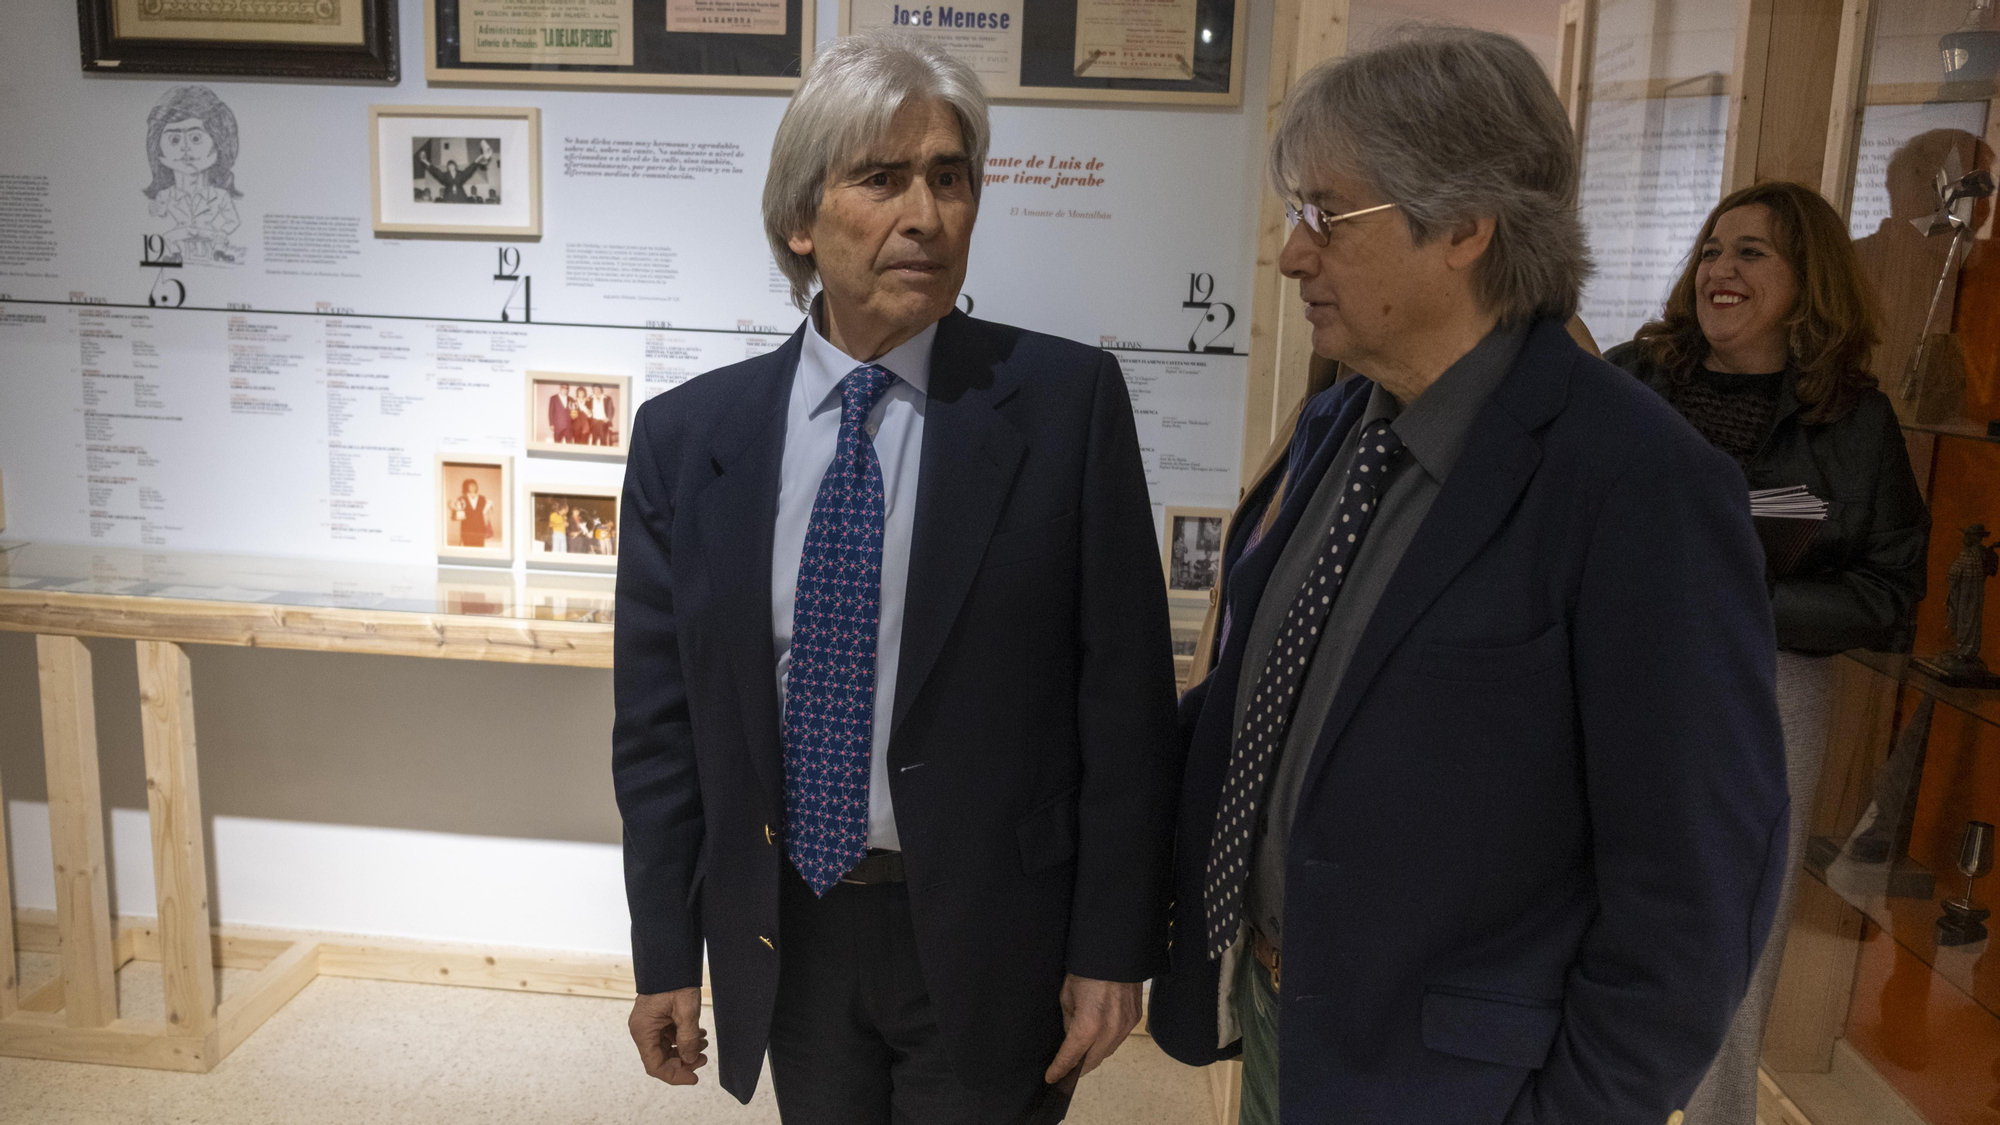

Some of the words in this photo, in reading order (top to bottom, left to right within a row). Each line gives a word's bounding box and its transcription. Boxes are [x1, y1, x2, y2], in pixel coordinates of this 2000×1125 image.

[893, 4, 933, 27] José
[938, 6, 1010, 30] Menese
[478, 25, 538, 36] Administración
[502, 38, 510, 48] de
[511, 38, 538, 49] Posadas
[1026, 155, 1044, 169] de
[1048, 155, 1082, 170] Luis
[1085, 157, 1104, 171] de
[983, 173, 1009, 187] que
[1013, 171, 1051, 185] tiene
[1050, 172, 1105, 190] jarabe
[1010, 207, 1019, 216] El
[1021, 208, 1054, 217] Amante
[1055, 209, 1065, 218] de
[1068, 209, 1112, 220] Montalbán
[139, 233, 165, 262] 19
[495, 246, 521, 276] 19
[1186, 272, 1215, 303] 19
[1182, 301, 1236, 354] 72
